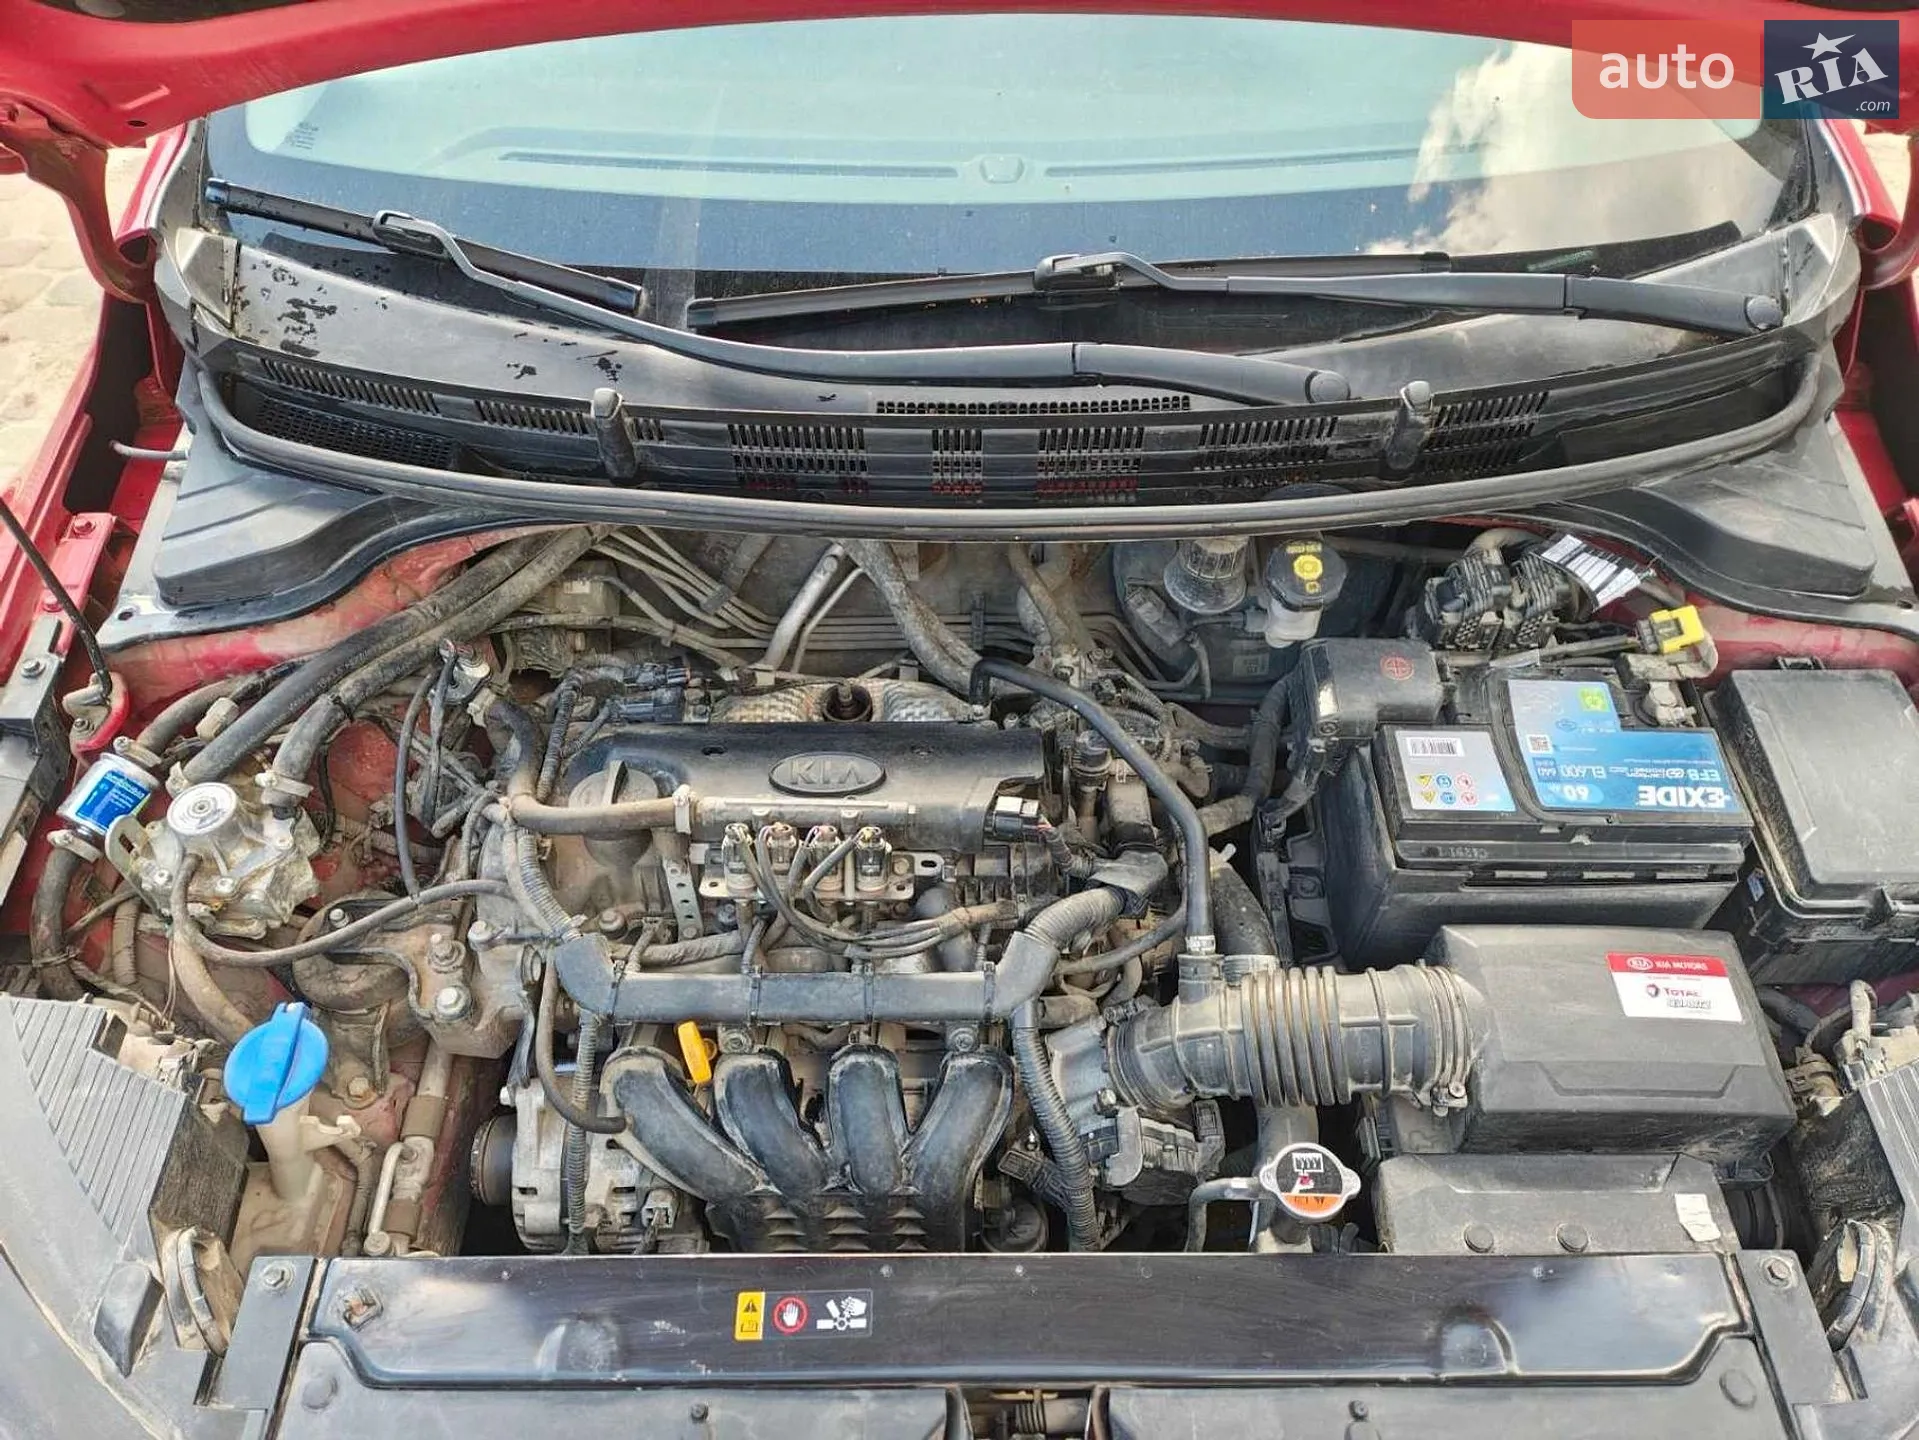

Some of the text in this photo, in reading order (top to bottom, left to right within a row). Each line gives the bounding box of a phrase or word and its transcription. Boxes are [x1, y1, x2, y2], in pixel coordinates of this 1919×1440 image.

[789, 759, 866, 785] KIA
[1687, 768, 1721, 782] EFB
[1563, 784, 1590, 801] 60
[1637, 785, 1727, 809] EXIDE
[1663, 986, 1702, 998] TOTAL
